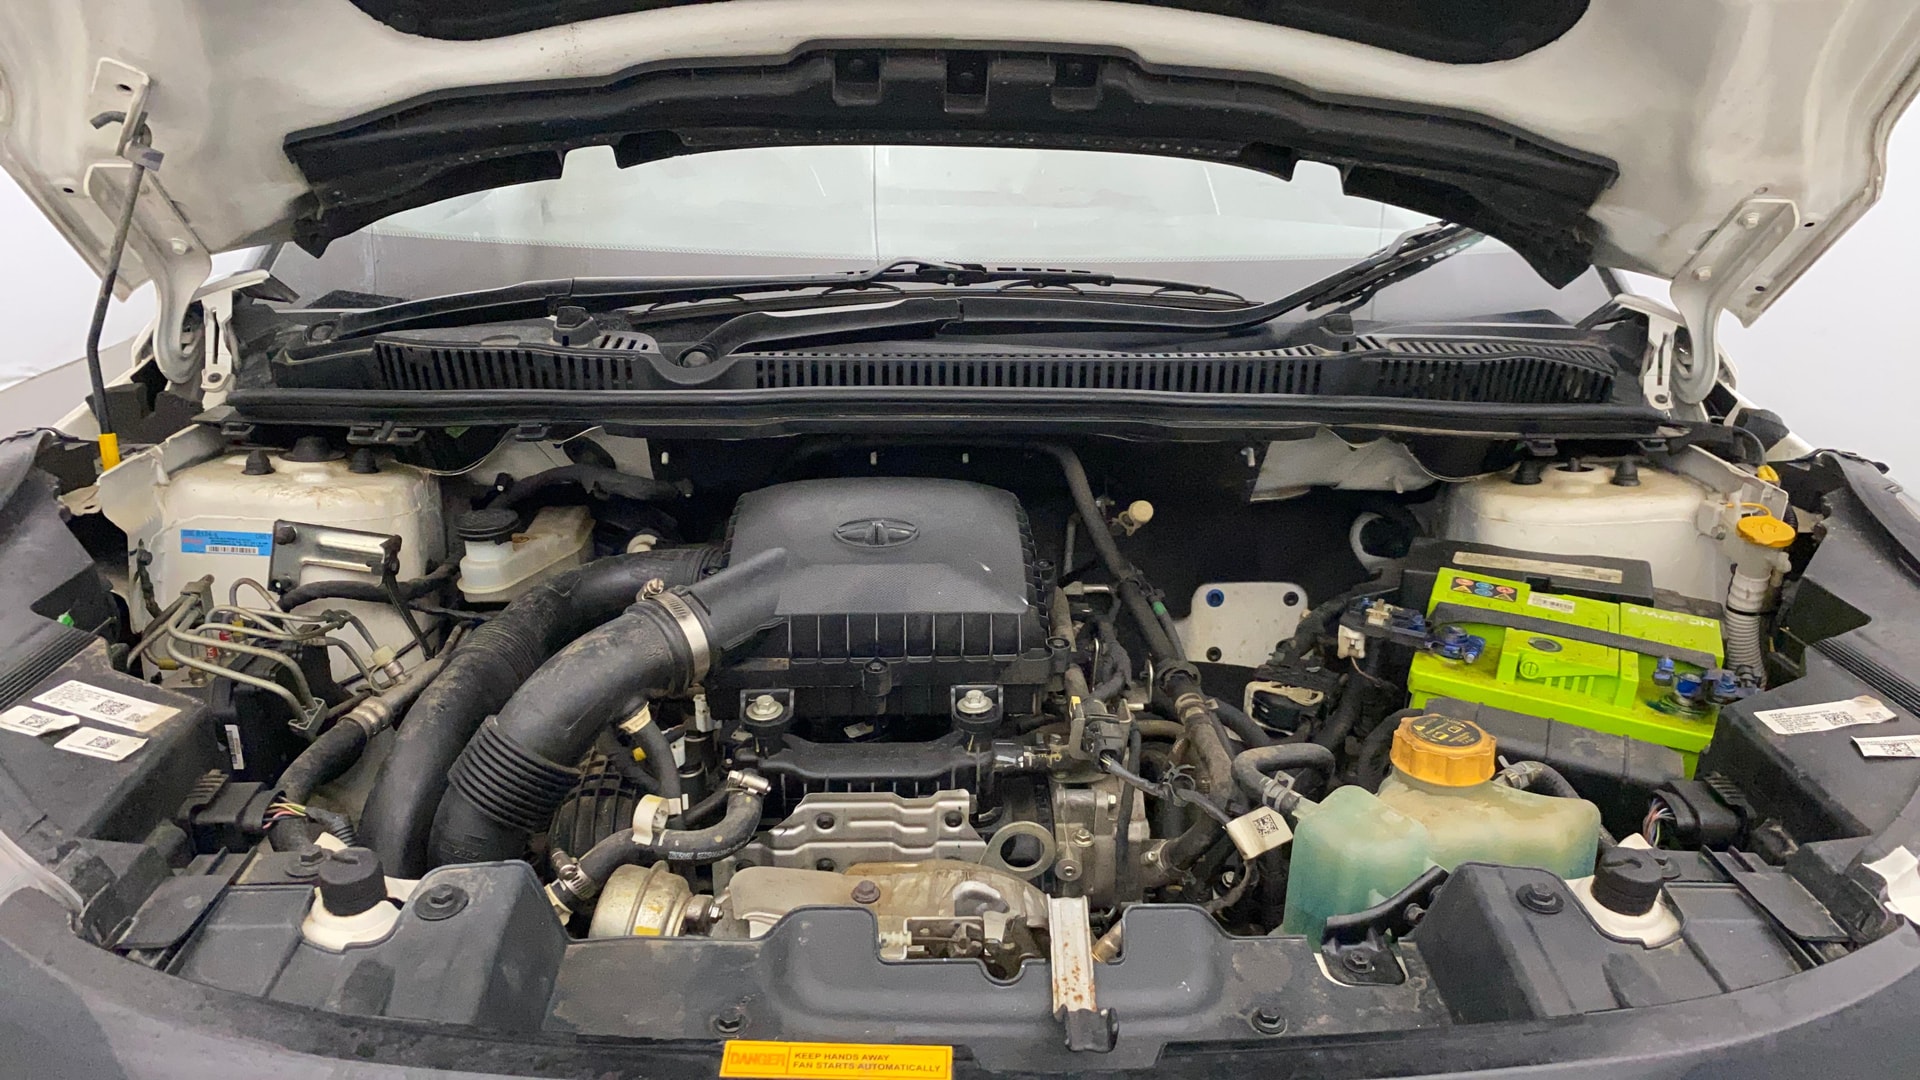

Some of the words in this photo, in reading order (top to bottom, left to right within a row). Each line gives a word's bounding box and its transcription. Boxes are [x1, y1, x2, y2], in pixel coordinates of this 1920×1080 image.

[730, 1052, 786, 1067] DANGER
[794, 1052, 821, 1060] KEEP
[824, 1053, 859, 1061] HANDS
[793, 1061, 813, 1069] FAN
[816, 1062, 855, 1070] STARTS
[857, 1062, 941, 1073] AUTOMATICALLY
